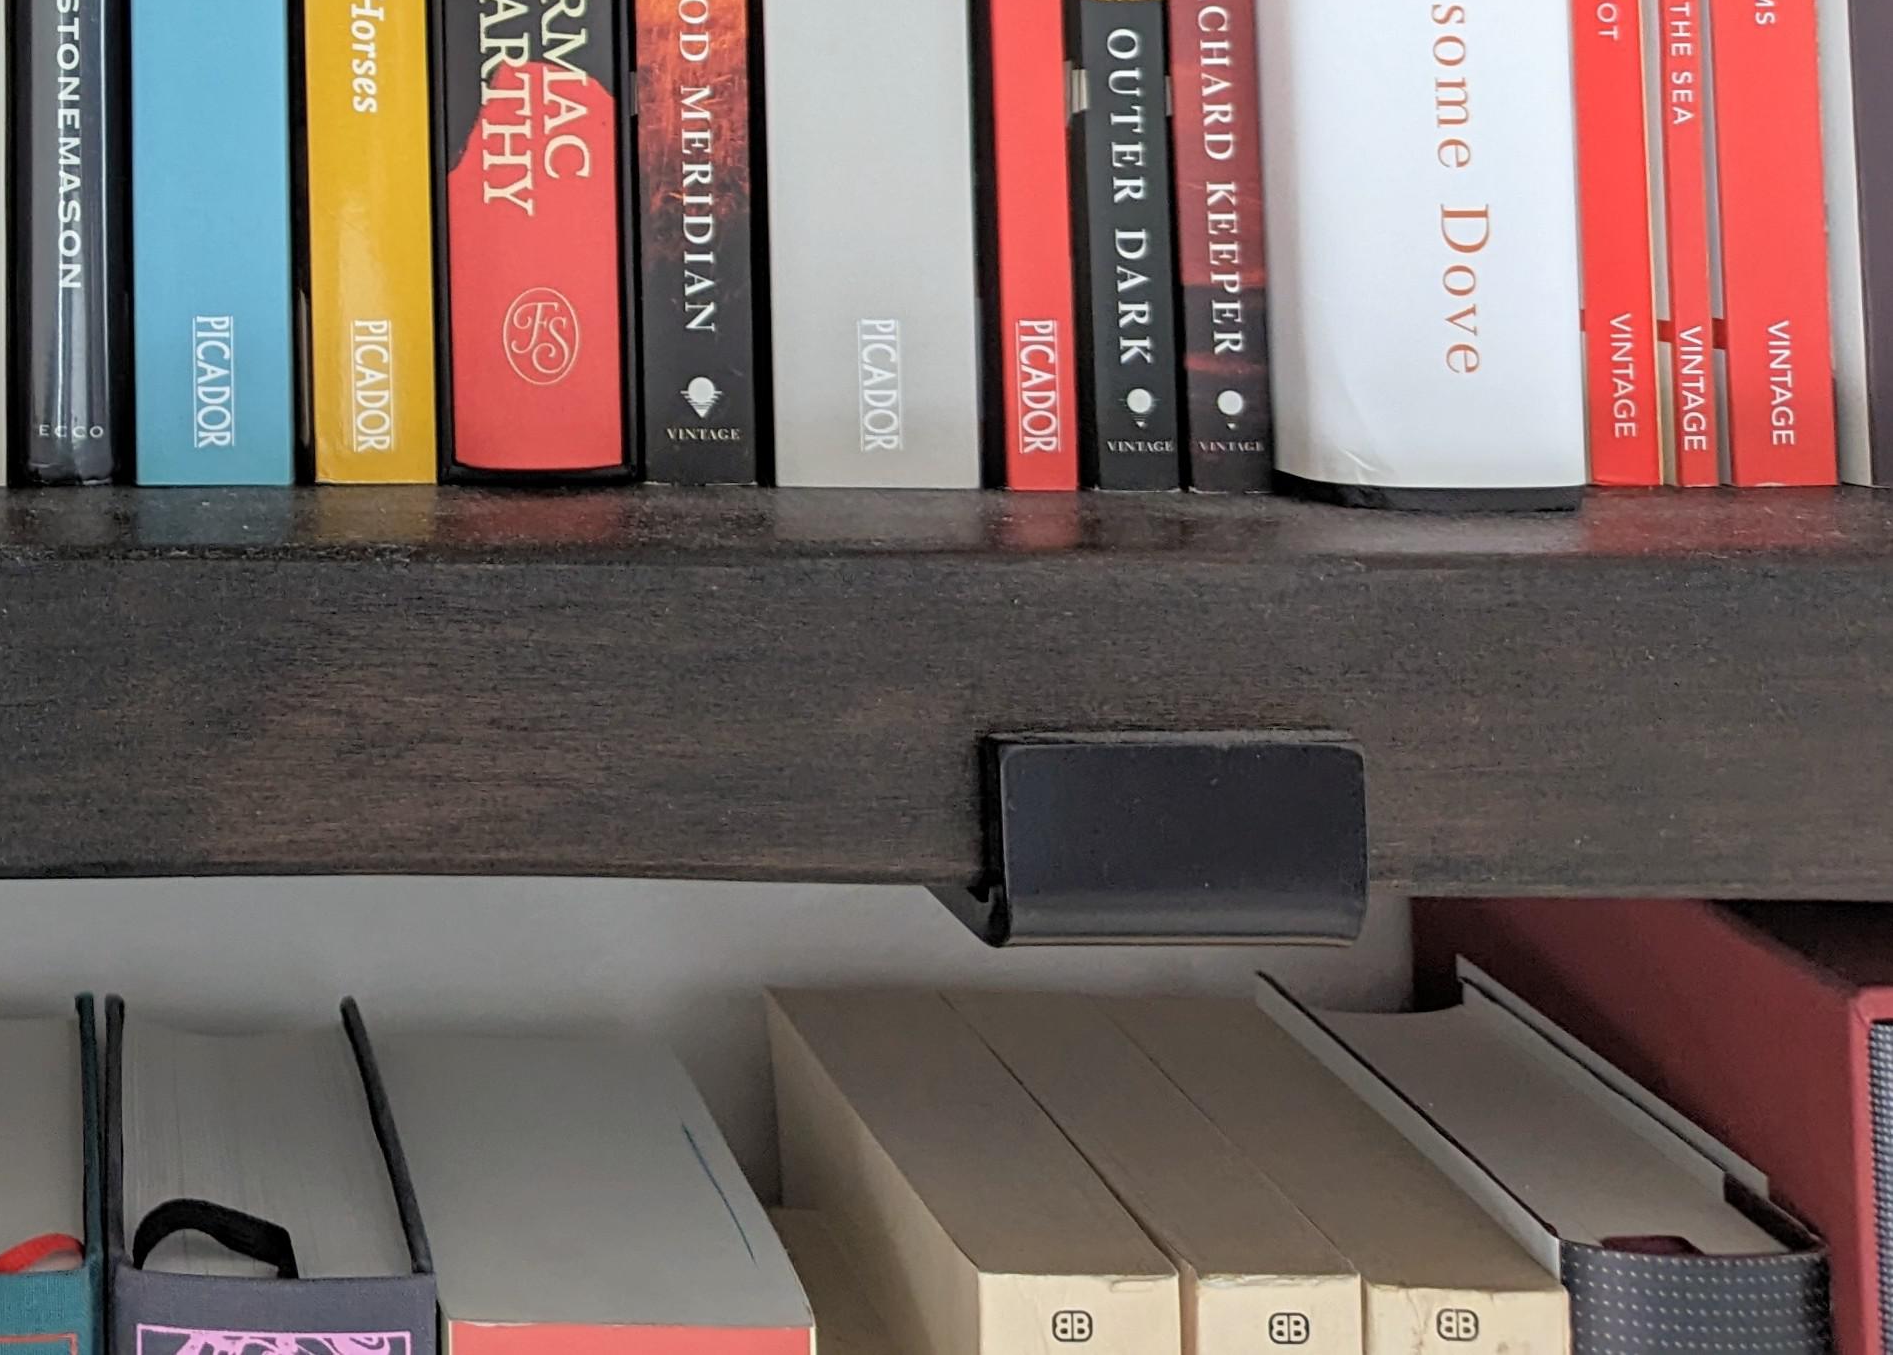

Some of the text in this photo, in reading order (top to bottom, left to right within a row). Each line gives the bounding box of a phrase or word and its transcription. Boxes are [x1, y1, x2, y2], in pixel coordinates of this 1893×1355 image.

[1669, 3, 1694, 57] THE
[1672, 72, 1696, 126] SEA
[680, 86, 716, 332] MERIDIAN
[1105, 28, 1152, 365] OUTER DARK
[1205, 181, 1244, 355] KEEPER
[1440, 204, 1490, 375] Dove
[39, 424, 104, 438] ECCO
[193, 315, 233, 447] PICADOR
[352, 319, 393, 452] PICADOR
[666, 428, 741, 441] VINTAGE
[858, 317, 902, 452] PICADOR
[1017, 318, 1058, 454] PICADOR
[1609, 312, 1636, 438] VINTAGE
[1679, 325, 1706, 451] VINTAGE
[1767, 320, 1795, 447] VINTAGE
[1107, 441, 1174, 452] VINTAGE
[1198, 441, 1264, 451] VINTAGE
